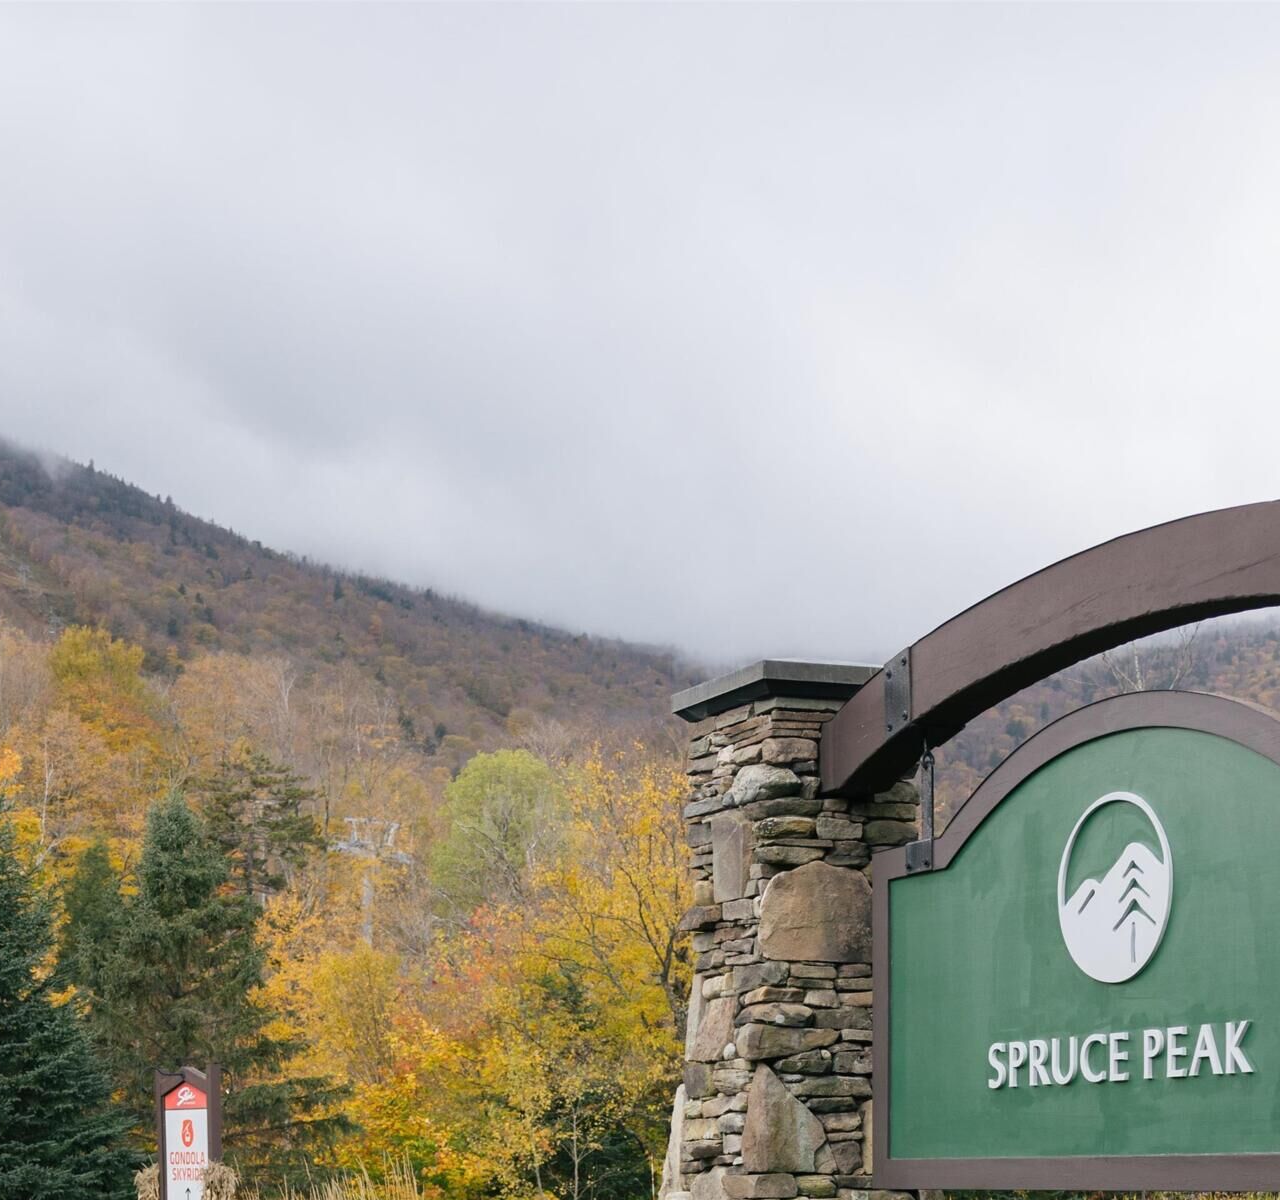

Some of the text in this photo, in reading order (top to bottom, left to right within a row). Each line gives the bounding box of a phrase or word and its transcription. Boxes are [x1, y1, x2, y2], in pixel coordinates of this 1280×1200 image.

[987, 1019, 1254, 1089] SPRUCE PEAK
[170, 1151, 205, 1165] GONDOLA
